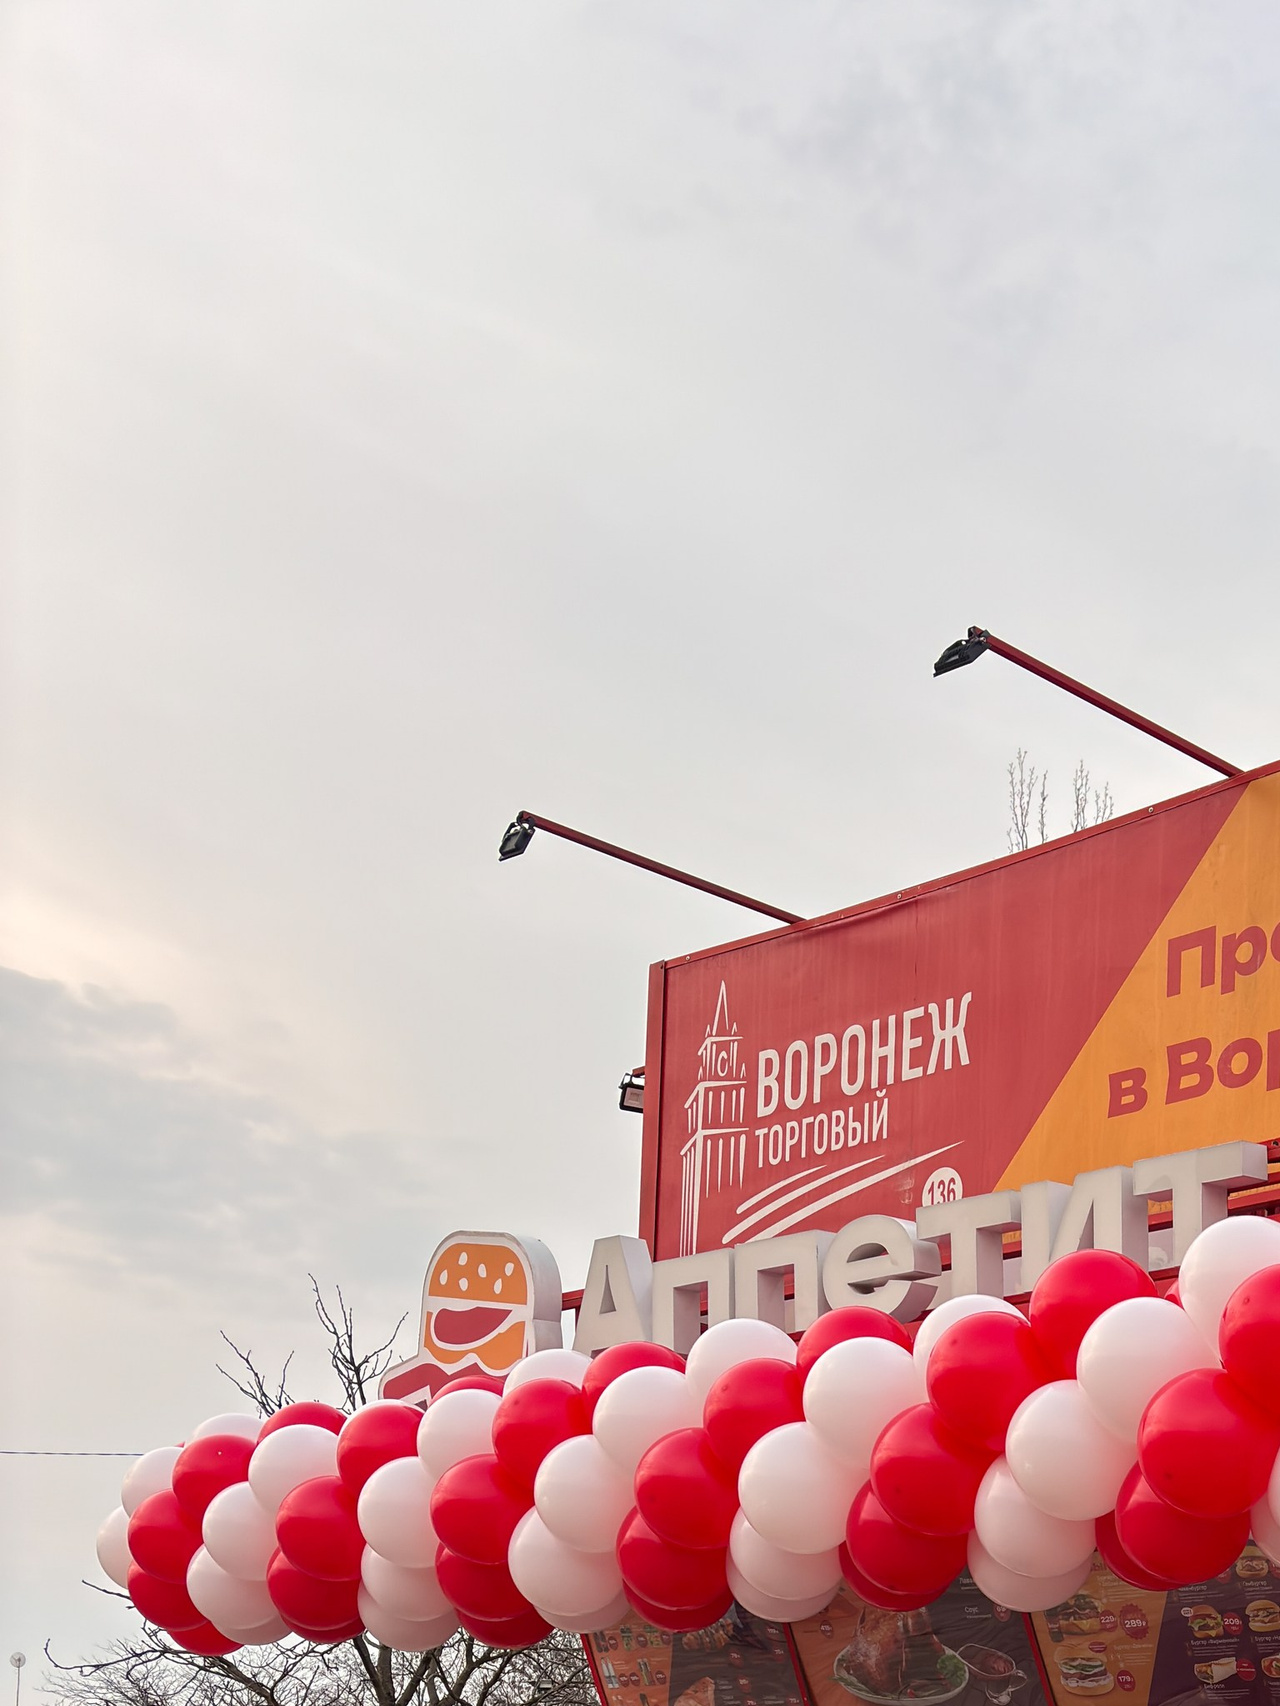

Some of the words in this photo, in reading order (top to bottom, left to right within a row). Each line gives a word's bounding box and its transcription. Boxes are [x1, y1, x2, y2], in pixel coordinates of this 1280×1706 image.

[756, 991, 973, 1118] ВОРОНЕЖ
[1107, 1068, 1148, 1118] в
[755, 1090, 889, 1168] ТОРГОВЫЙ
[928, 1177, 956, 1205] 136
[573, 1140, 1268, 1357] Аппетит
